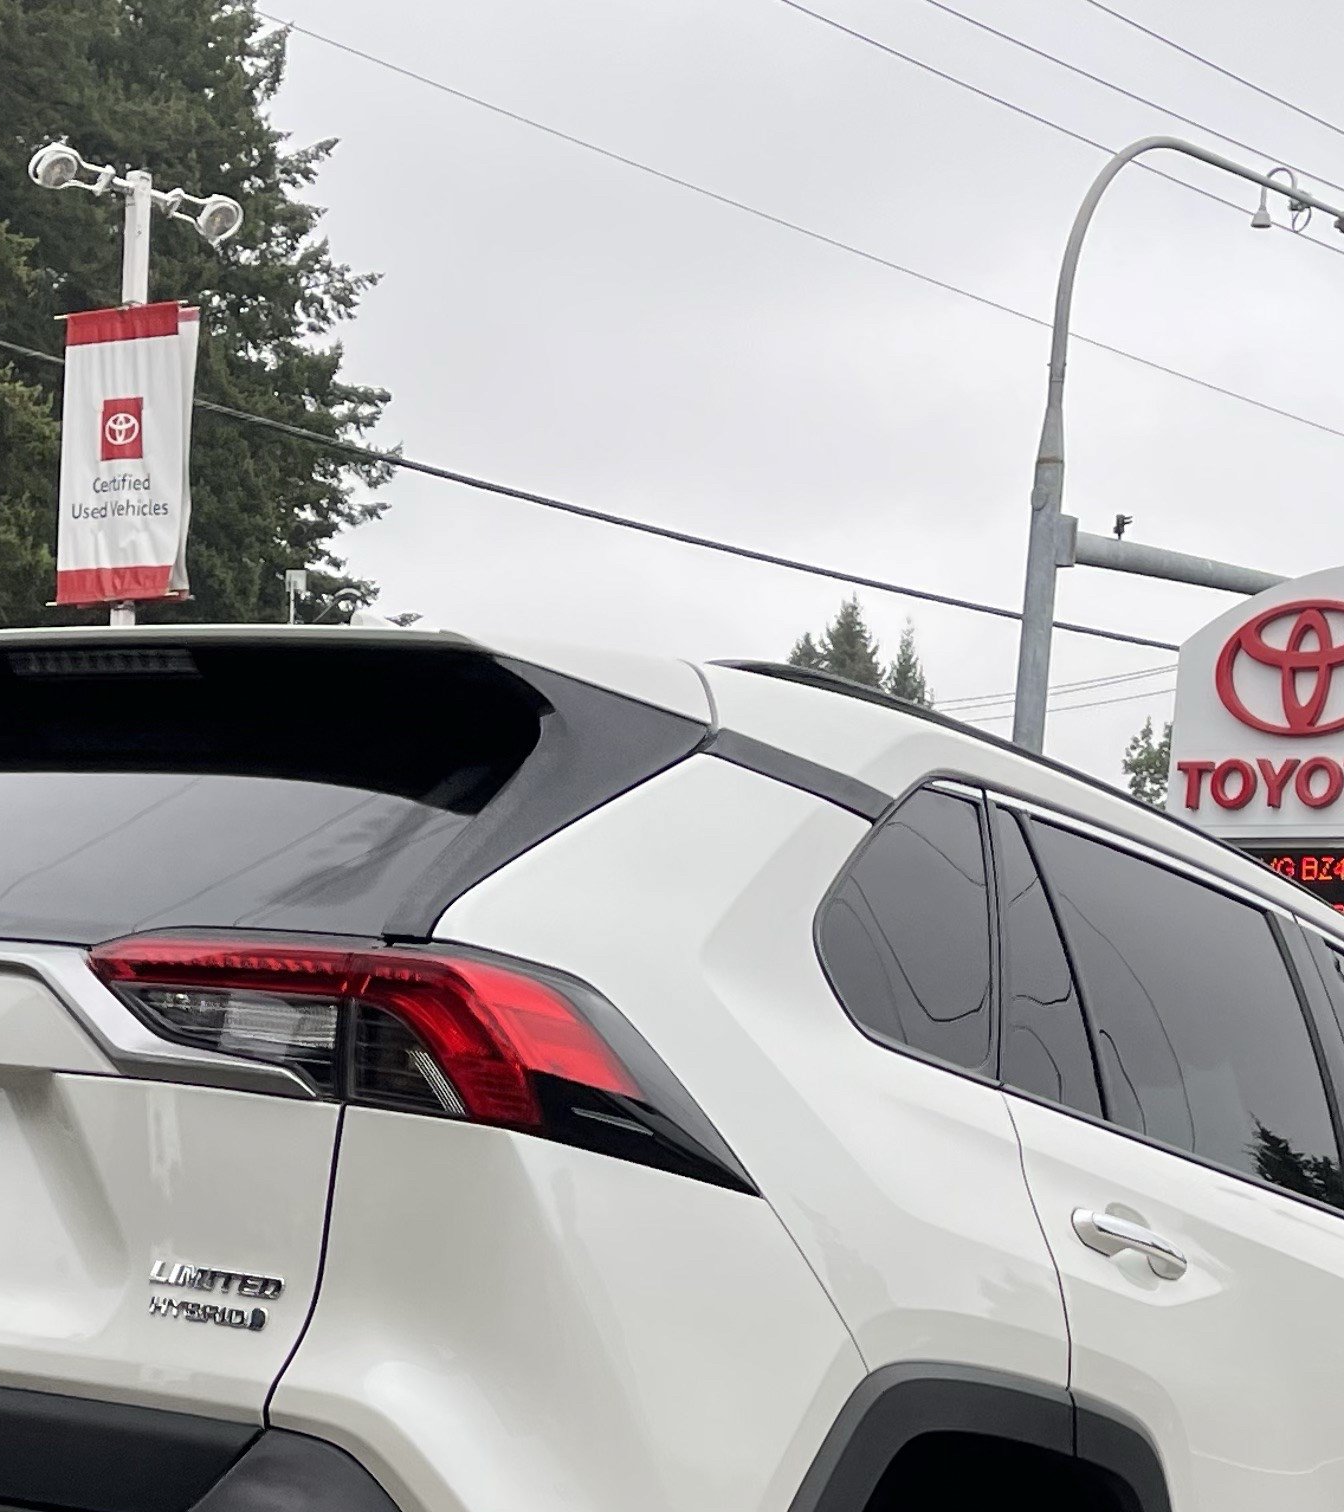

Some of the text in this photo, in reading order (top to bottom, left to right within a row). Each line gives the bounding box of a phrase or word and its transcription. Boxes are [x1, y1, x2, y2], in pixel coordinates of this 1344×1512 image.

[92, 472, 151, 494] Certified
[71, 501, 169, 520] Used Vehicles
[149, 1259, 286, 1300] LIMITED
[149, 1296, 248, 1329] HYBRID
